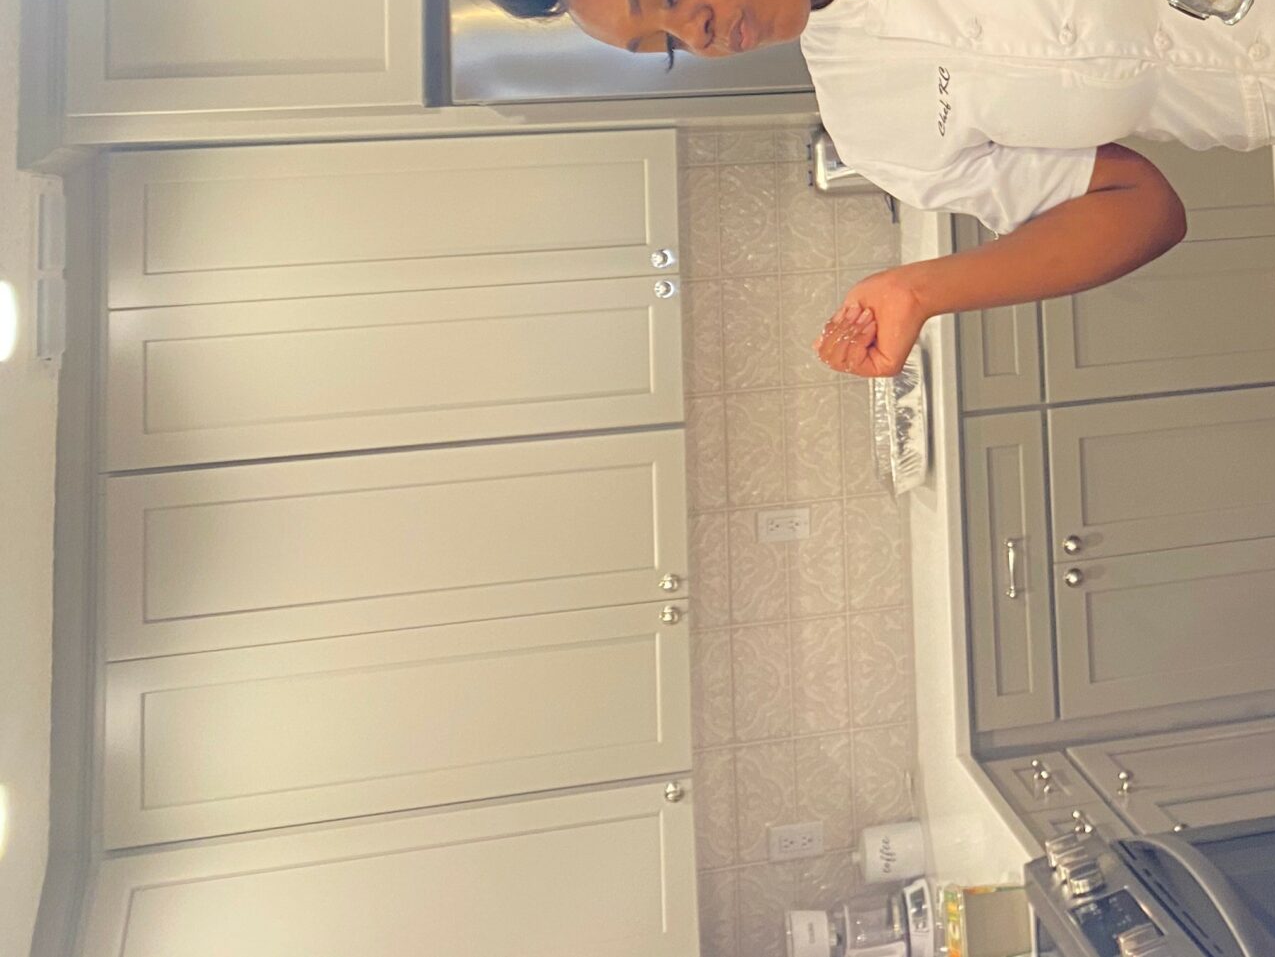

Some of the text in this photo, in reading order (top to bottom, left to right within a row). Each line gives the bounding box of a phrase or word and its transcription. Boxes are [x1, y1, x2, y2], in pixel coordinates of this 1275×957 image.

[938, 66, 951, 136] Chef KC
[880, 836, 896, 873] coffee
